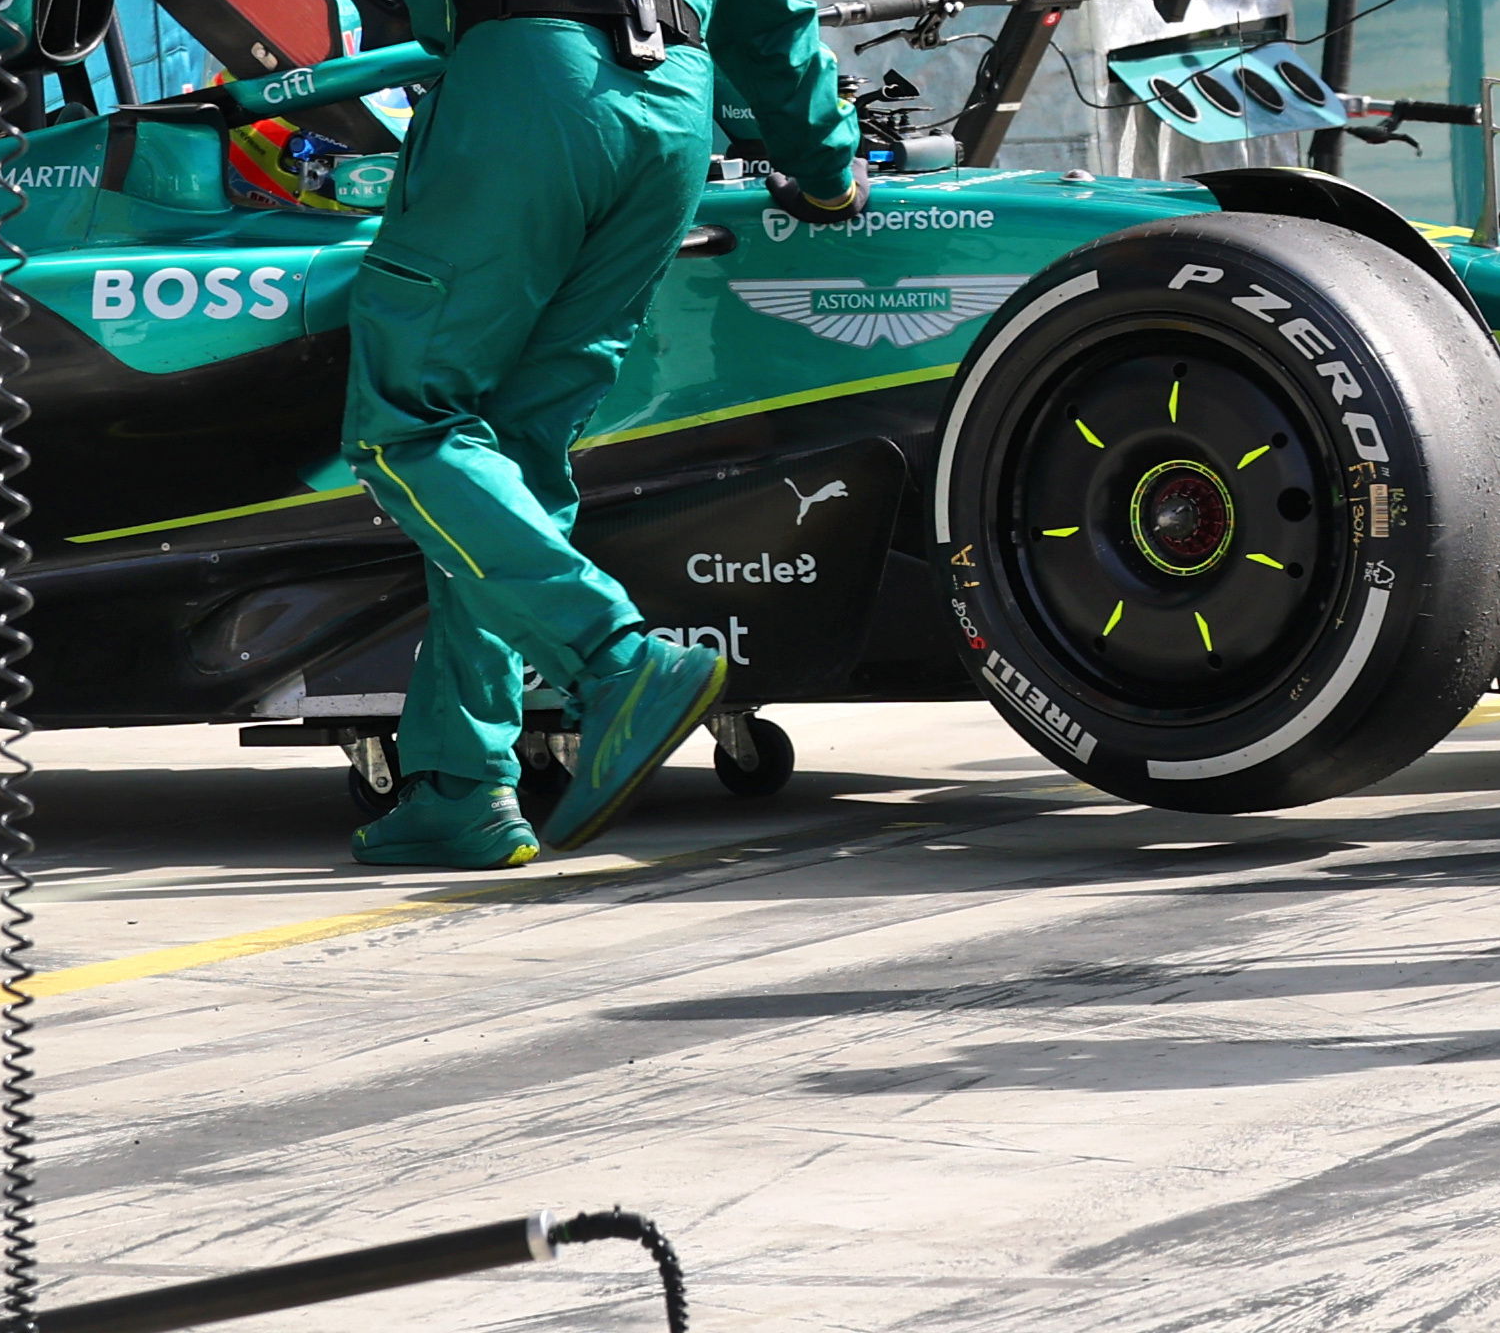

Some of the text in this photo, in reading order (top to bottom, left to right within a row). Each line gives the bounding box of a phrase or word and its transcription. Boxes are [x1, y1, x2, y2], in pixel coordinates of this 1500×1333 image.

[263, 67, 315, 106] citi
[91, 266, 290, 321] BOSS
[817, 291, 947, 310] ASTON MARTIN
[1168, 263, 1390, 463] P ZERO
[981, 649, 1099, 766] PIRELLI
